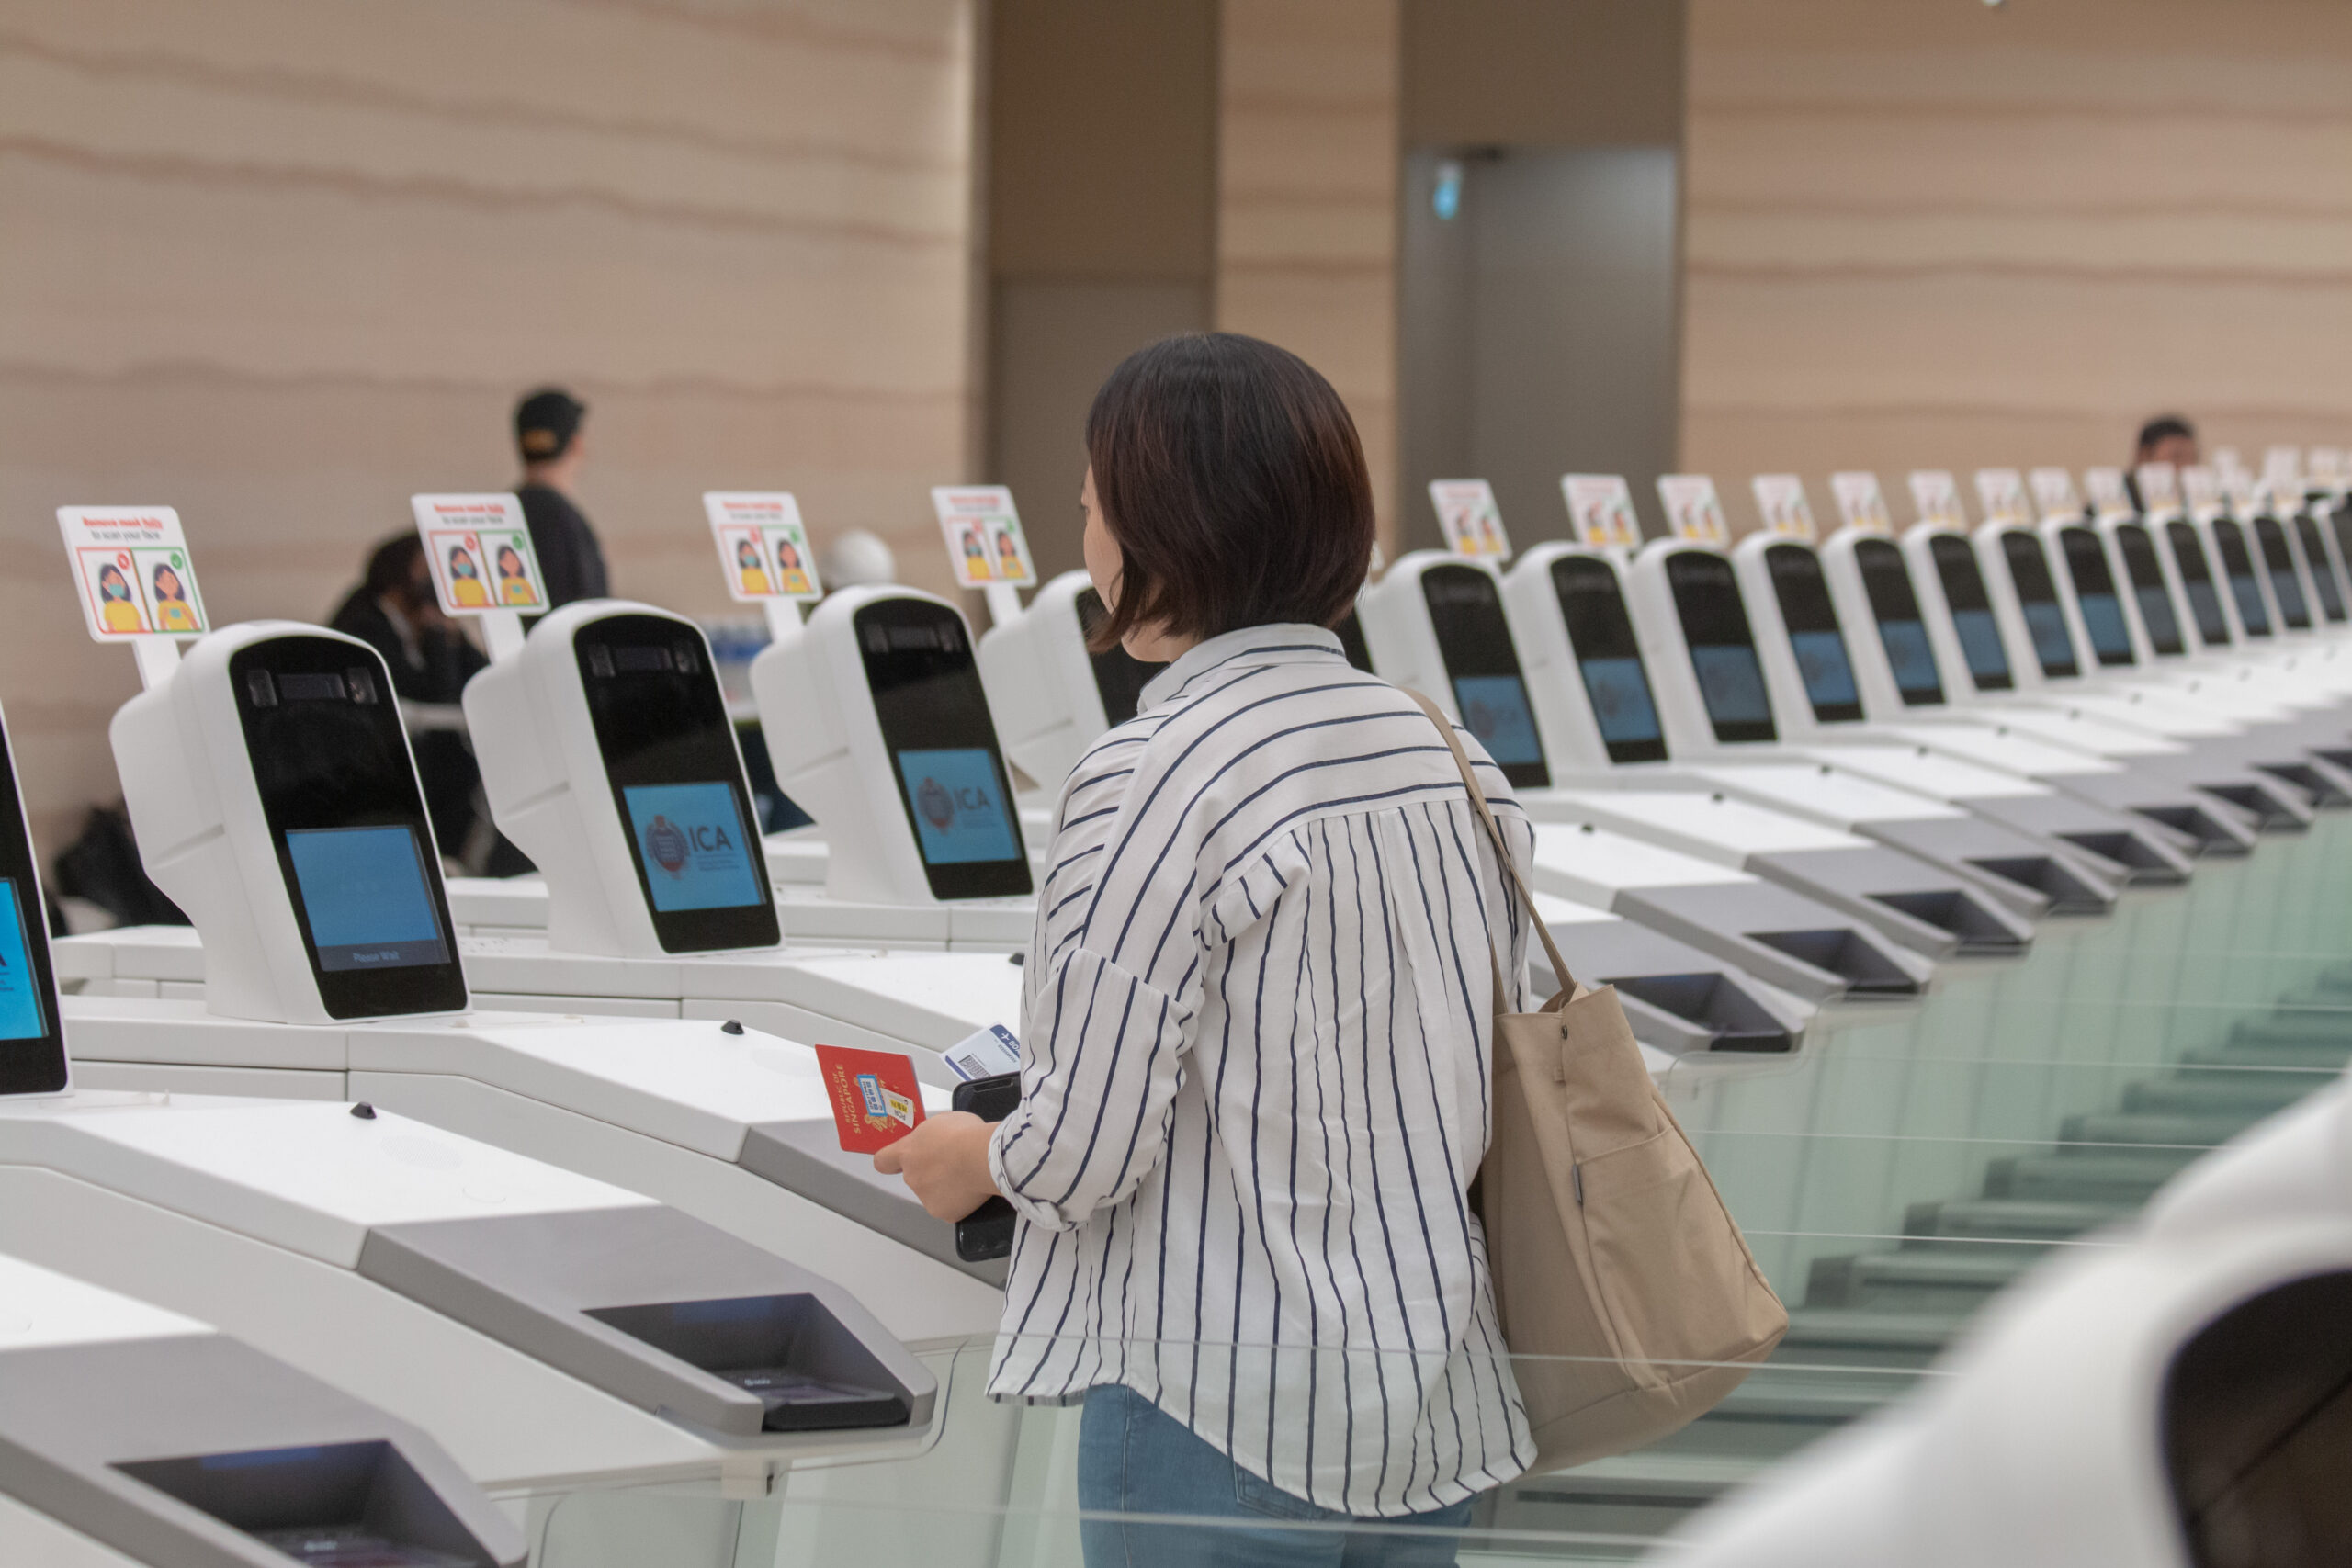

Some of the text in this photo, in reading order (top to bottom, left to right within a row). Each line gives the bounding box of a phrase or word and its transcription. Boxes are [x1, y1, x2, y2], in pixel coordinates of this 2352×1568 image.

[82, 517, 117, 527] Remove
[119, 518, 141, 528] mask
[954, 786, 992, 811] ICA
[688, 825, 734, 852] ICA
[832, 1072, 851, 1123] REPUBLIC OF
[835, 1064, 862, 1134] SINGAPORE
